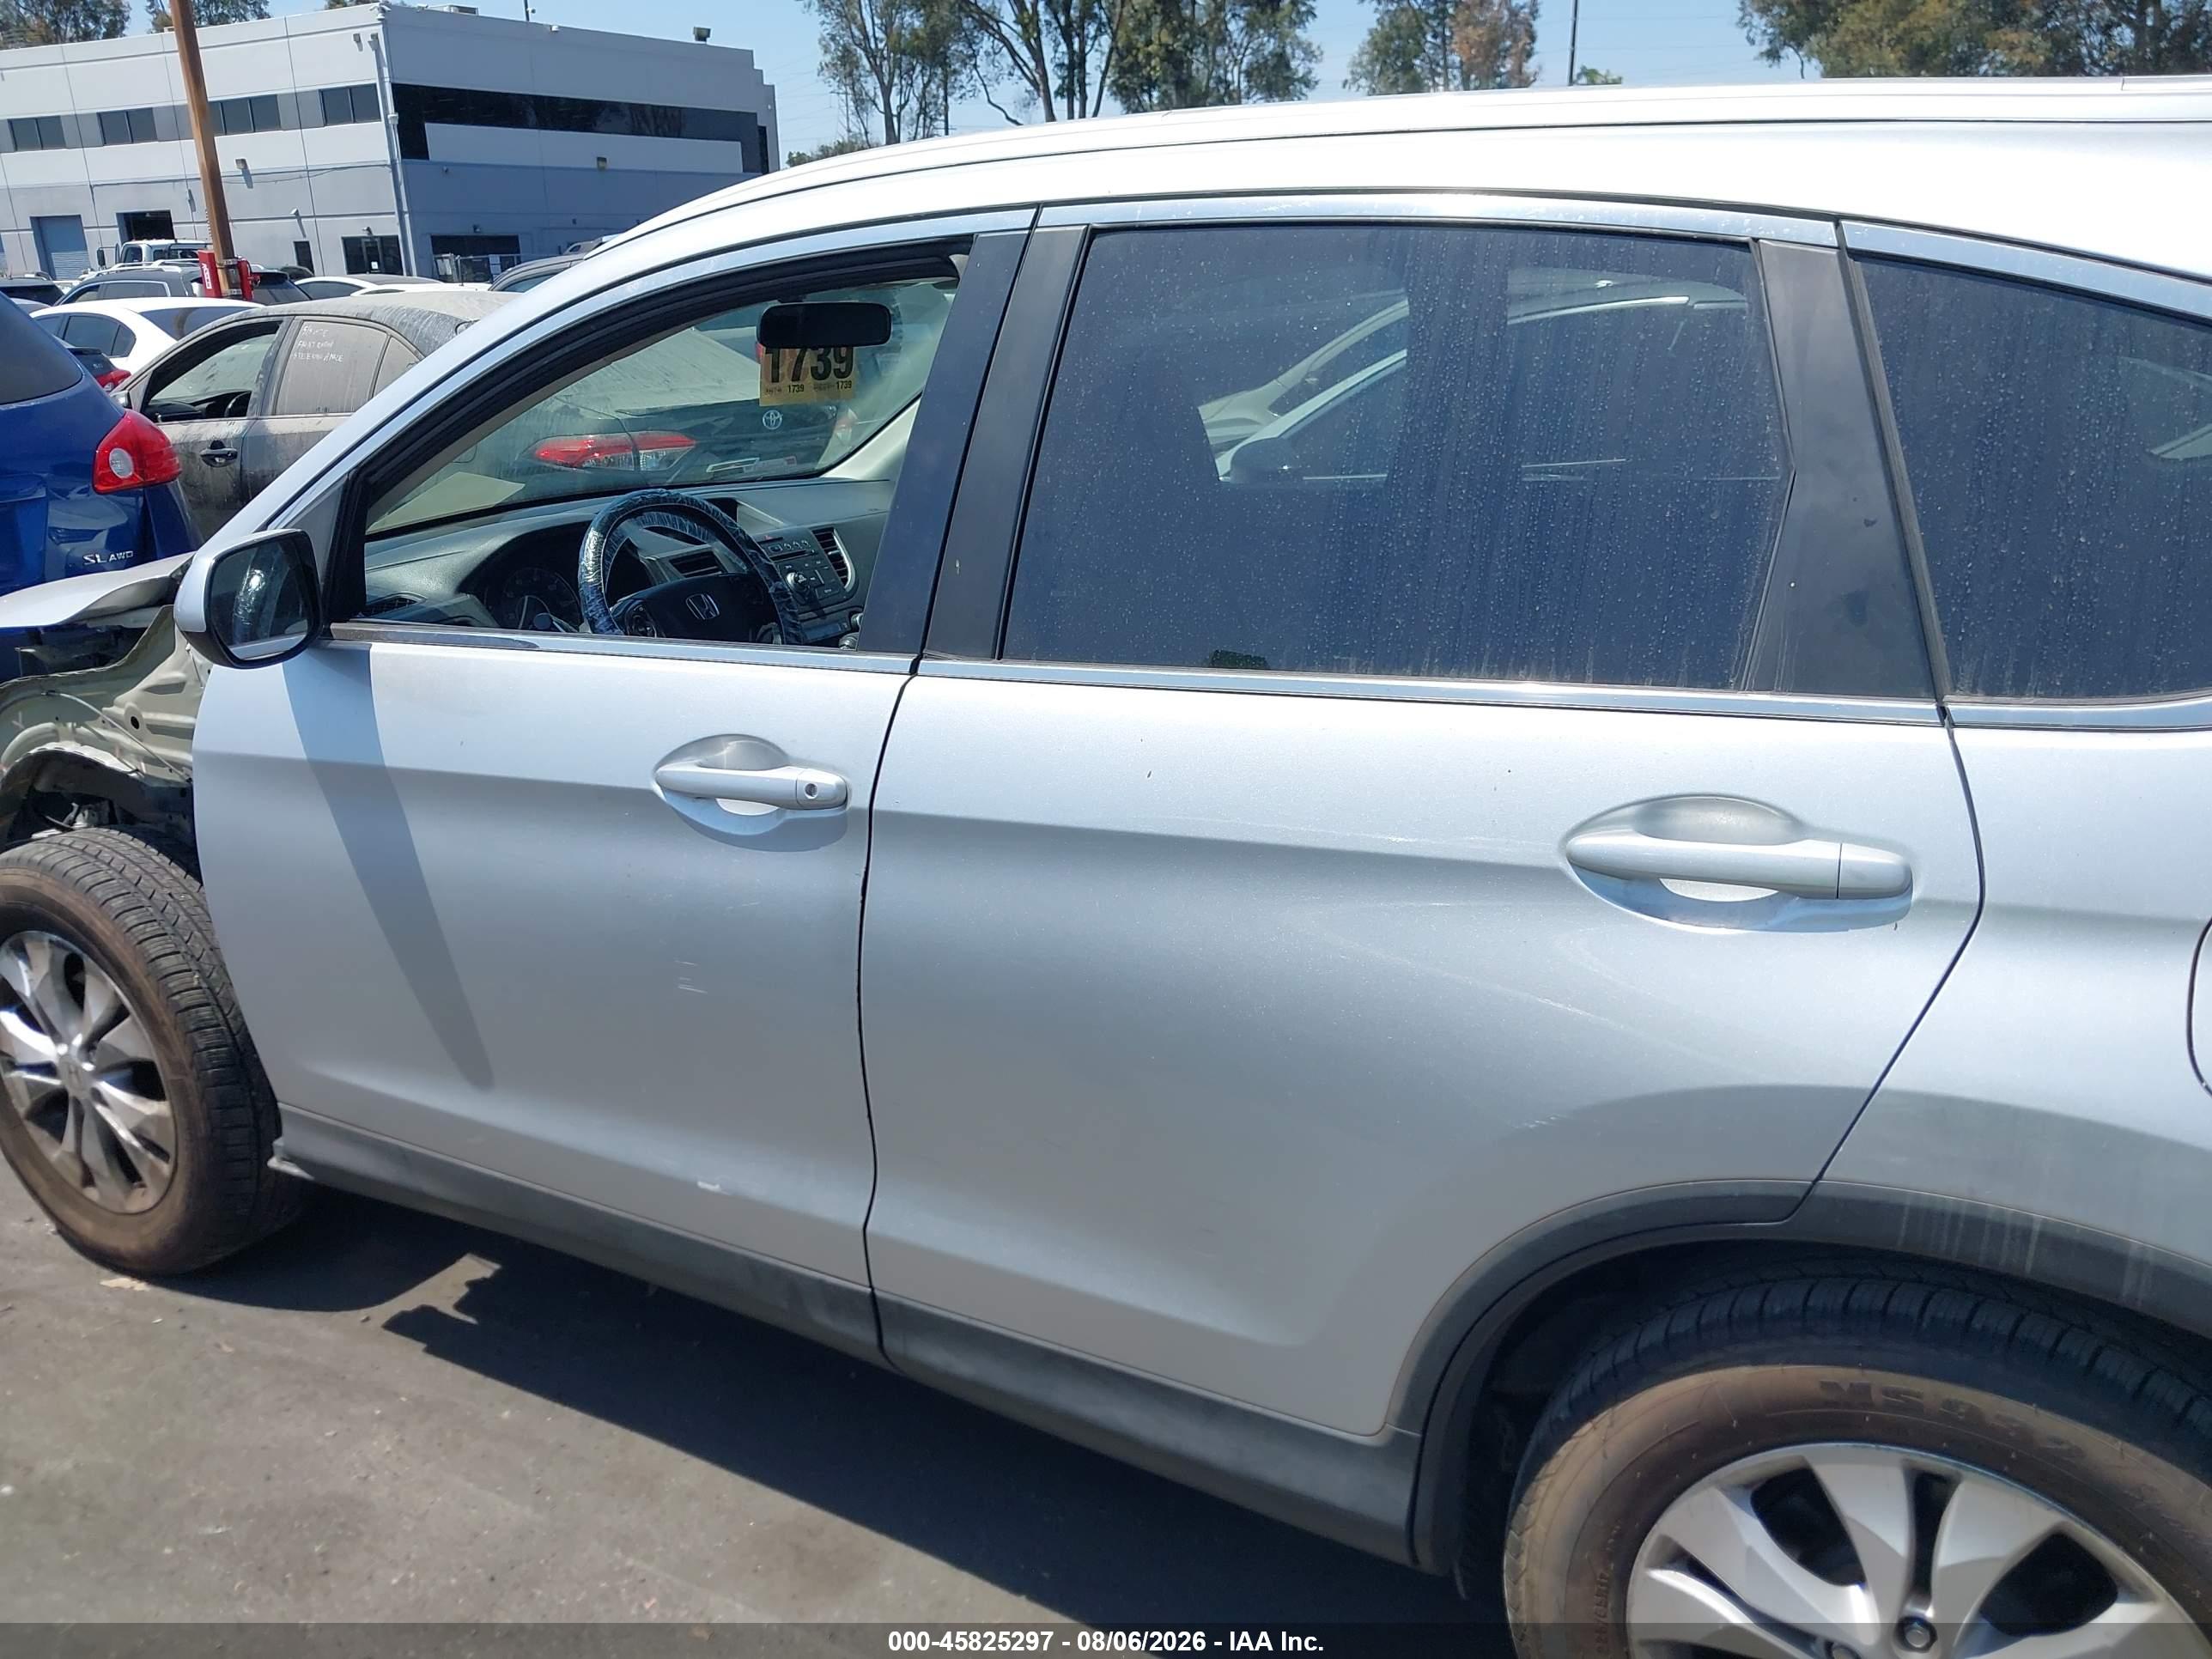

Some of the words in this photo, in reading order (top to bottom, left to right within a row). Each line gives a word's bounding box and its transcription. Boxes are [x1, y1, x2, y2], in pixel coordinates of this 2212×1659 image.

[765, 347, 854, 383] 1739
[787, 384, 805, 392] 1739
[836, 380, 852, 390] 1739
[82, 553, 107, 565] SL
[108, 550, 134, 562] AWD
